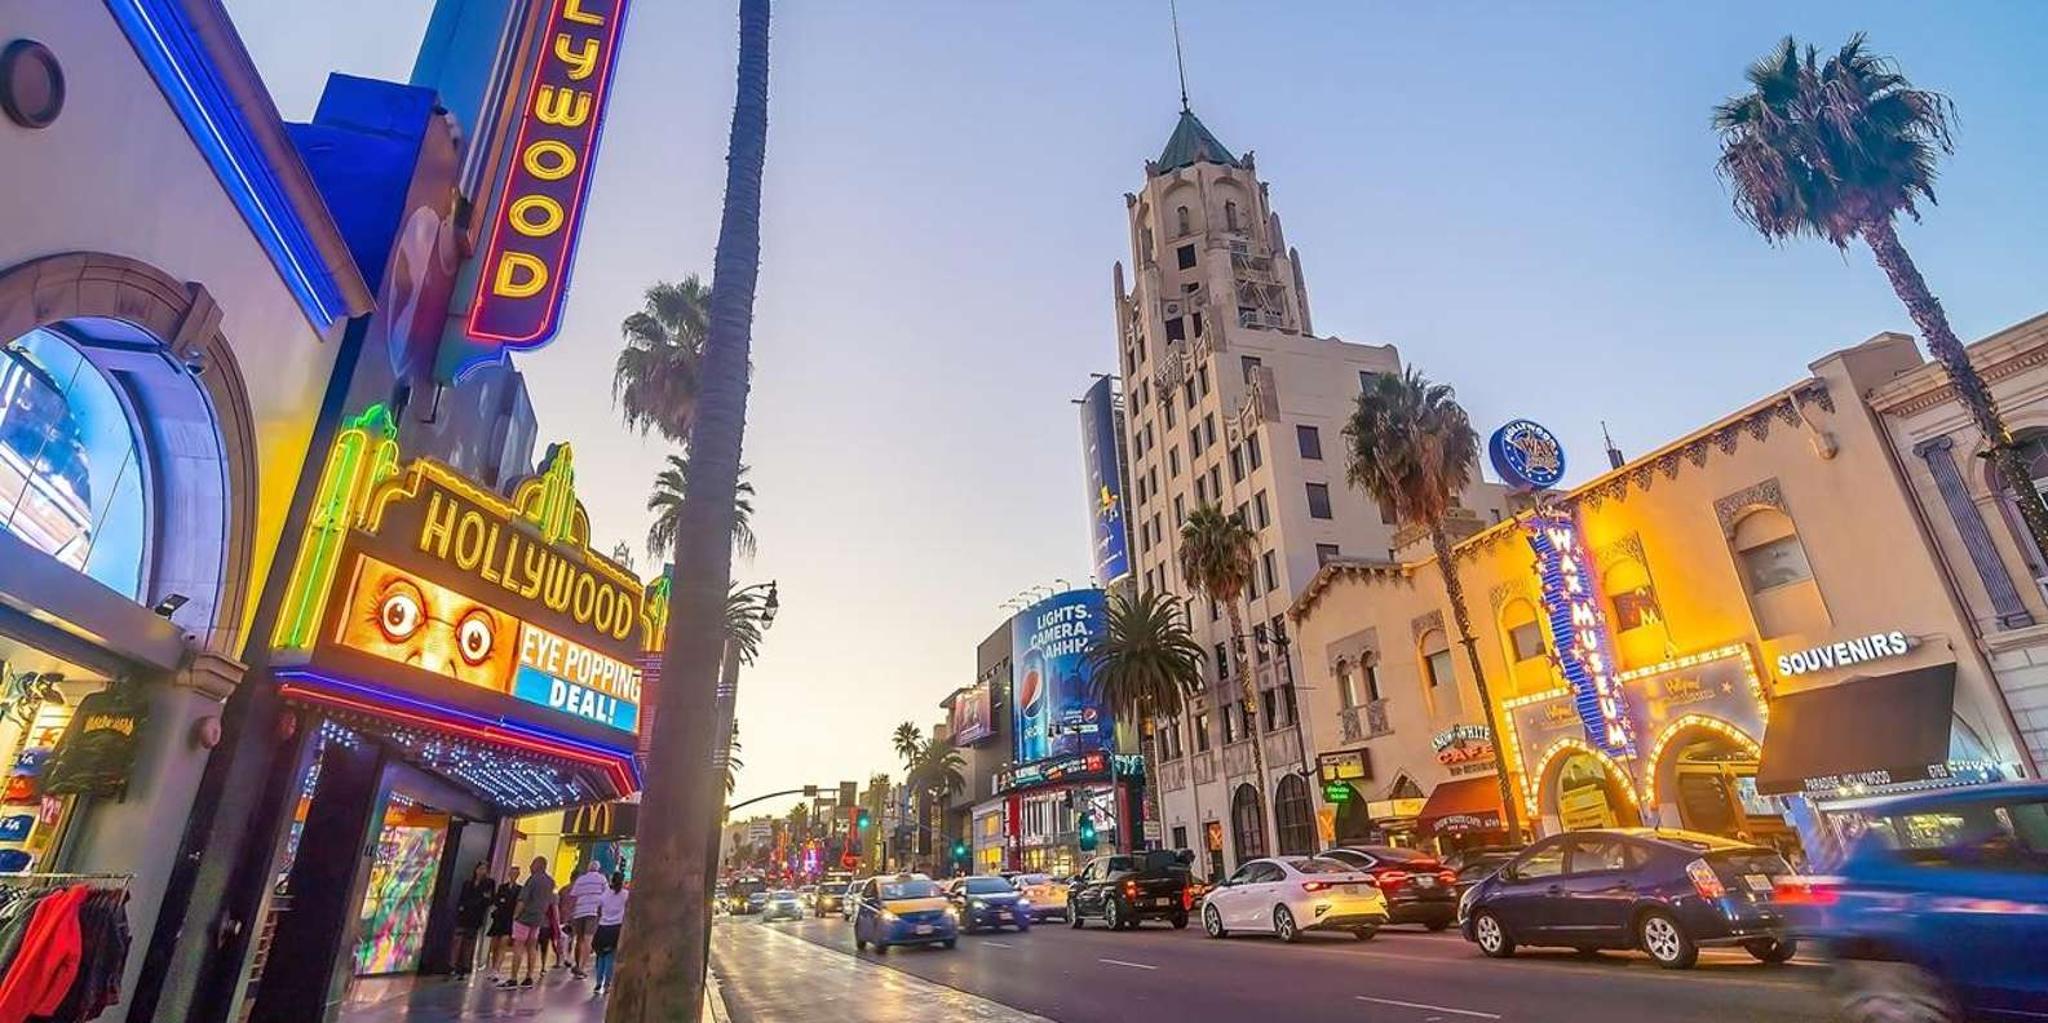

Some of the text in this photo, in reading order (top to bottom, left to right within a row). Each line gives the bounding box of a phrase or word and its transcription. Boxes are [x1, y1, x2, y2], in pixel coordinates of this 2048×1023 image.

[420, 491, 635, 642] HOLLYWOOD
[1031, 621, 1094, 648] CAMERA.
[1037, 604, 1092, 631] LIGHTS.
[1547, 528, 1628, 747] WAX MUSEUM
[520, 630, 643, 702] EYE POPPING
[1777, 631, 1908, 677] SOUVENIRS
[550, 680, 618, 722] DEAL!
[1457, 725, 1491, 741] WHITE
[1843, 770, 1891, 787] HOLLYWOOD
